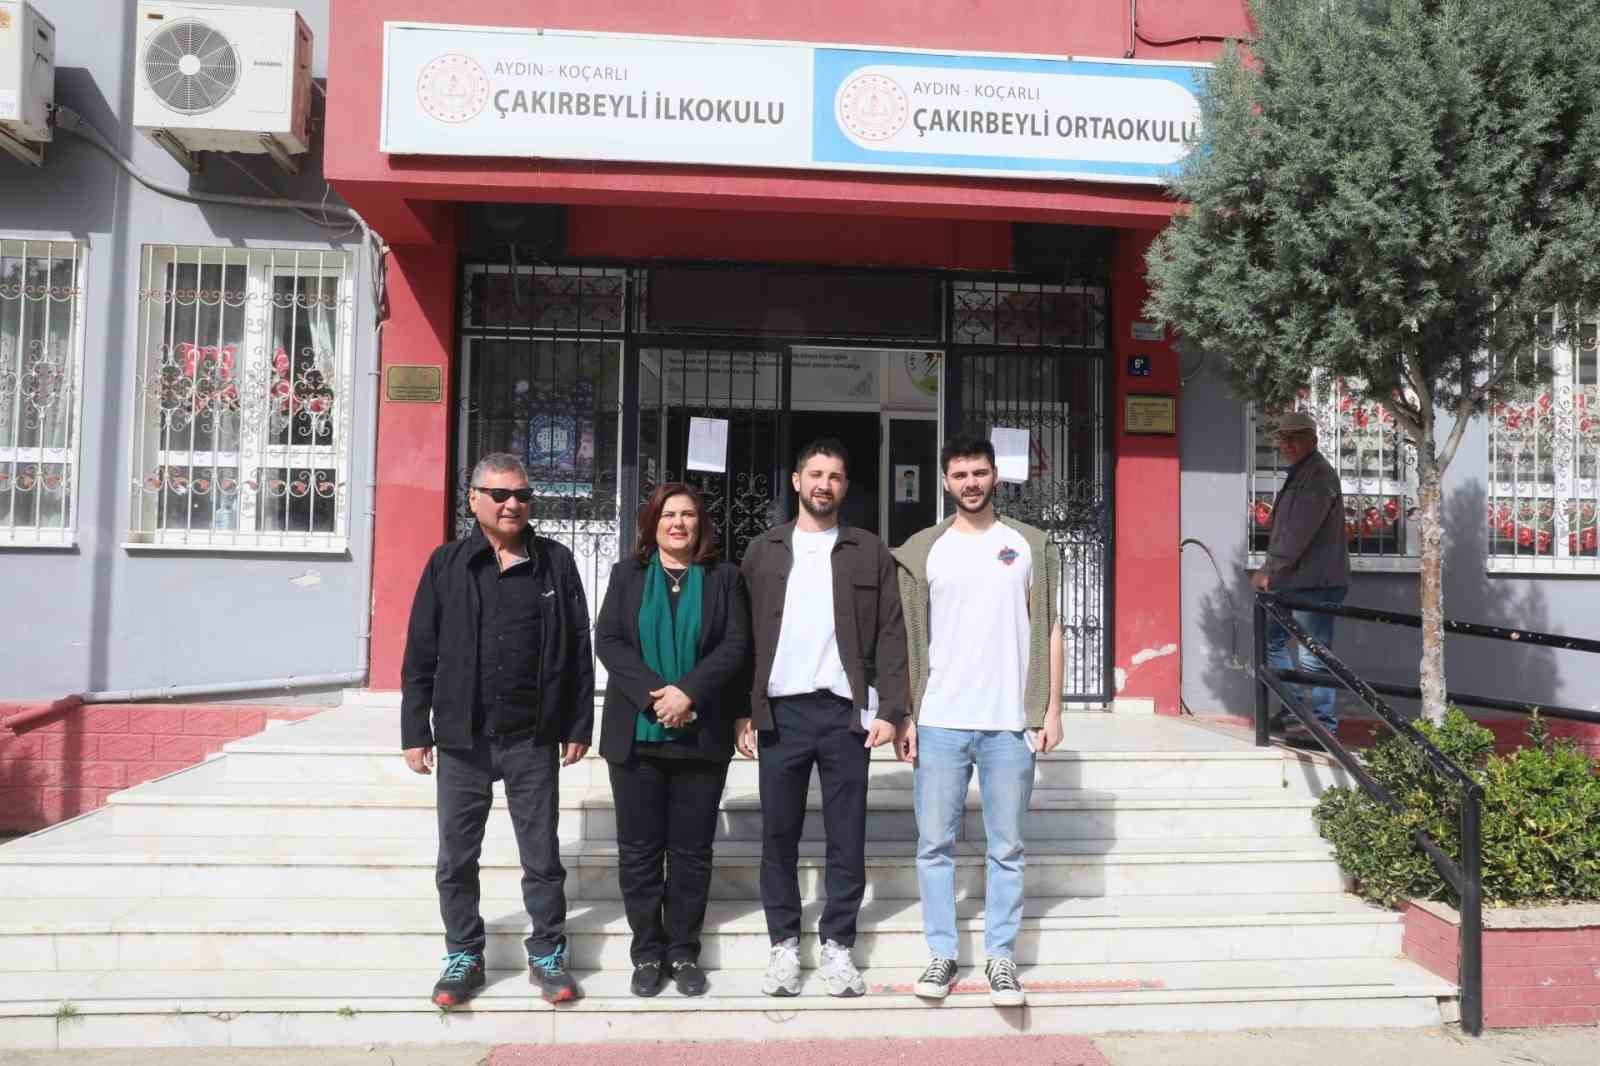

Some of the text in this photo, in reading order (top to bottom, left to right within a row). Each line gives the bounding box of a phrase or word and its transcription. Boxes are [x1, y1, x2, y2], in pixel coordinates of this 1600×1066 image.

[495, 62, 544, 77] AYDIN
[559, 64, 628, 82] KOÇARLI
[913, 81, 961, 97] AYDIN
[975, 85, 1041, 101] KOÇARLI
[494, 89, 785, 125] ÇAKIRBEYLİ İLKOKULU
[913, 108, 1198, 144] ÇAKIRBEYLİ ORTAOKULU
